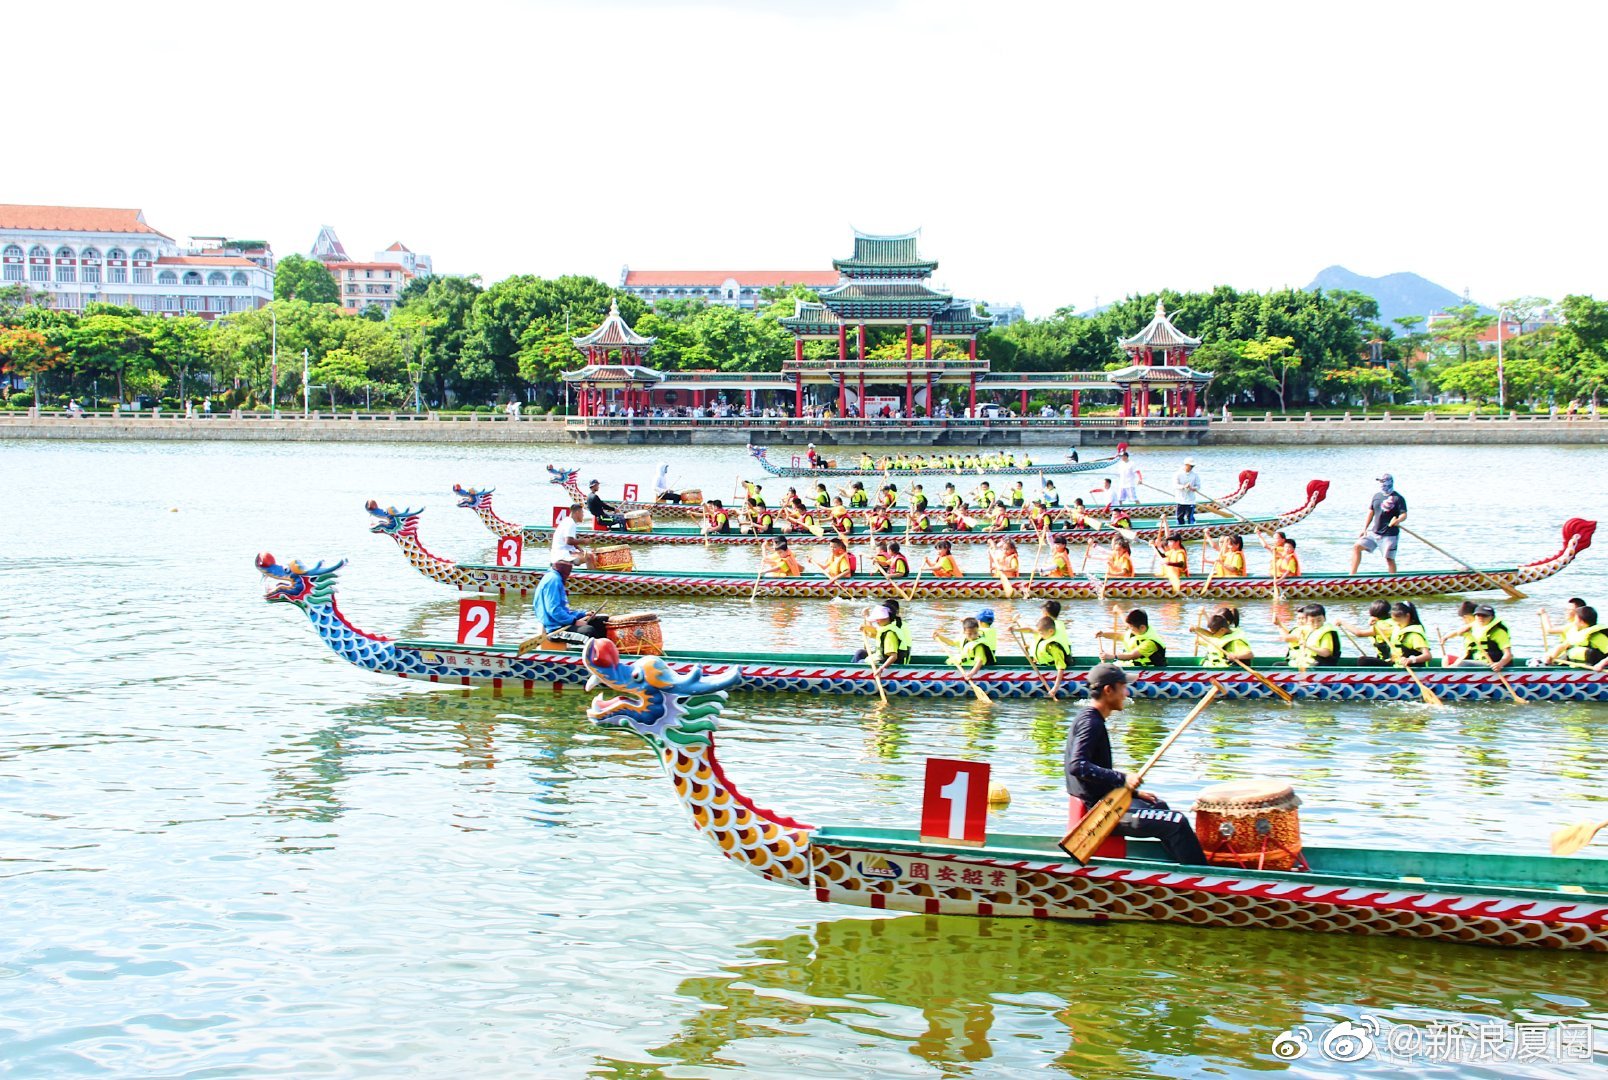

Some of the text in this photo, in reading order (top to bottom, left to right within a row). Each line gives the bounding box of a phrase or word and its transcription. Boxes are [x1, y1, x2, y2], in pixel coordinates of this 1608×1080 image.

[793, 457, 799, 468] 6
[626, 486, 636, 502] 5
[501, 538, 518, 567] 3
[464, 606, 490, 646] 2
[940, 771, 970, 840] 1
